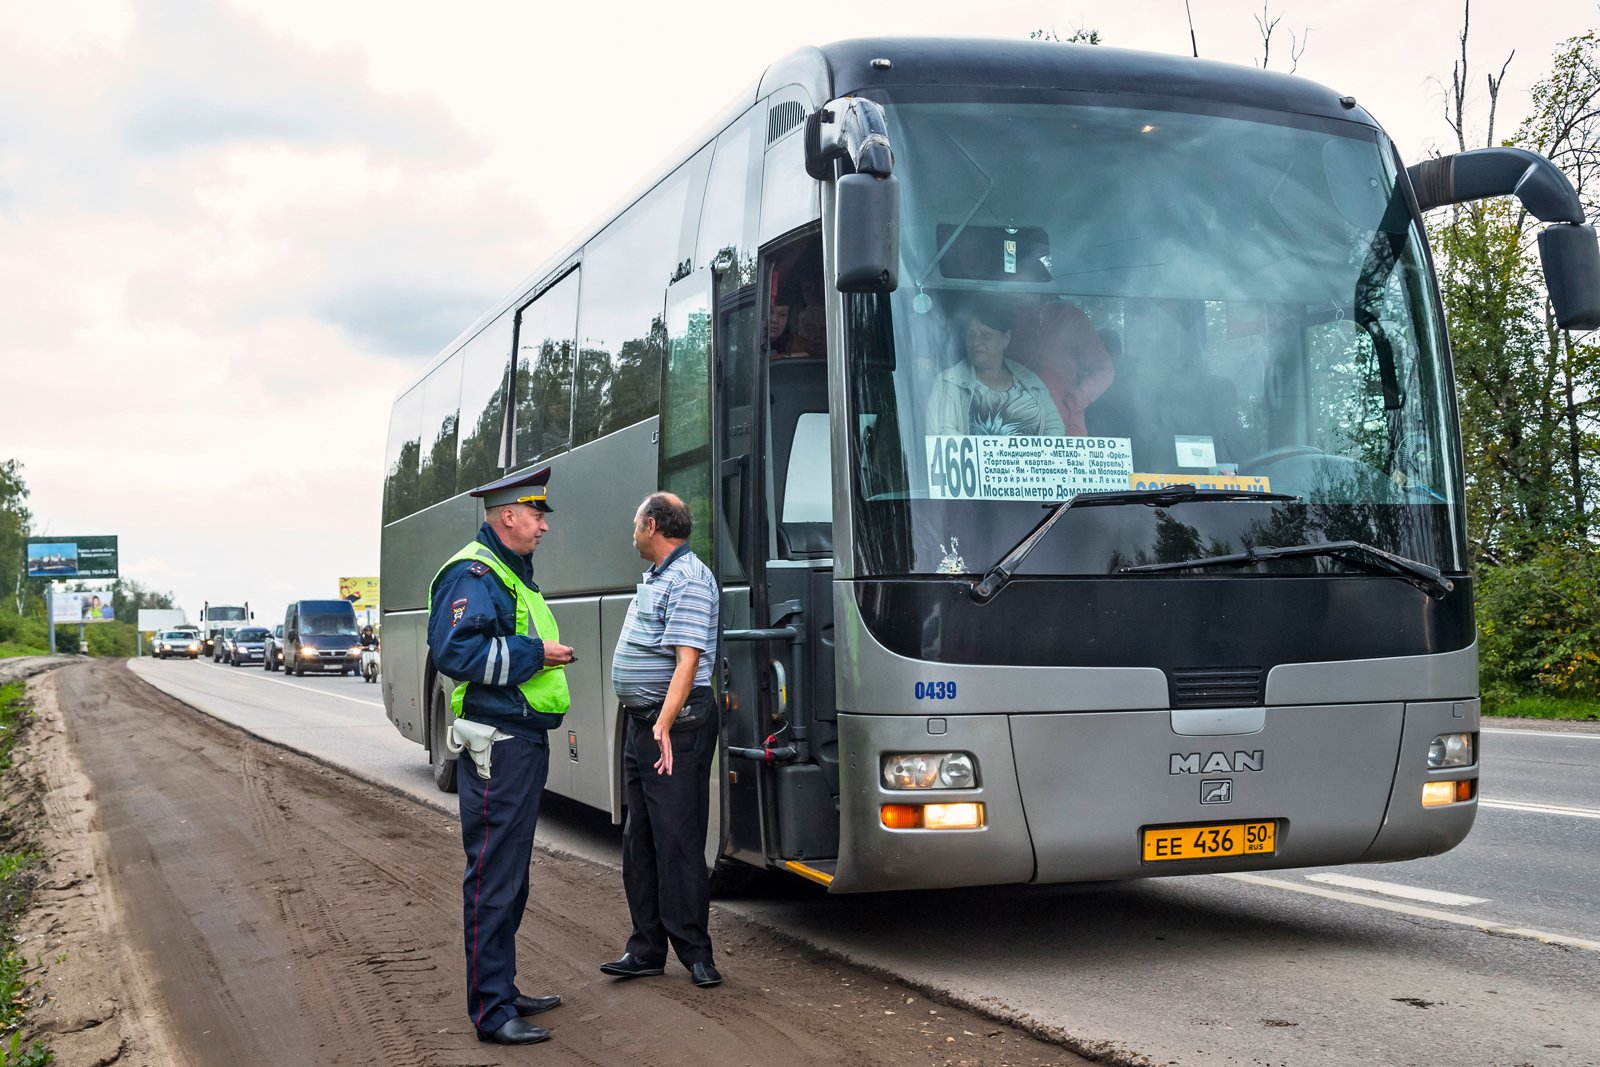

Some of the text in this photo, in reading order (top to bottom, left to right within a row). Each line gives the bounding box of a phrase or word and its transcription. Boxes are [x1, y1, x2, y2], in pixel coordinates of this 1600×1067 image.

[982, 437, 1116, 450] ст. ДОМОДЕДОВО
[1050, 450, 1081, 458] «МЕТАКО»
[1089, 451, 1104, 459] ПШО
[930, 437, 976, 498] 466
[984, 458, 1124, 468] «Торговый квартал» Базы (Карусель)
[984, 466, 1010, 475] Склады
[1030, 467, 1068, 475] Петровское
[1073, 467, 1087, 475] Пов.
[985, 474, 1046, 483] Стройрынок
[914, 681, 957, 700] 0439
[1169, 750, 1264, 775] MAN
[1246, 825, 1267, 843] 50
[1193, 829, 1234, 854] 436
[1248, 843, 1264, 851] RUS
